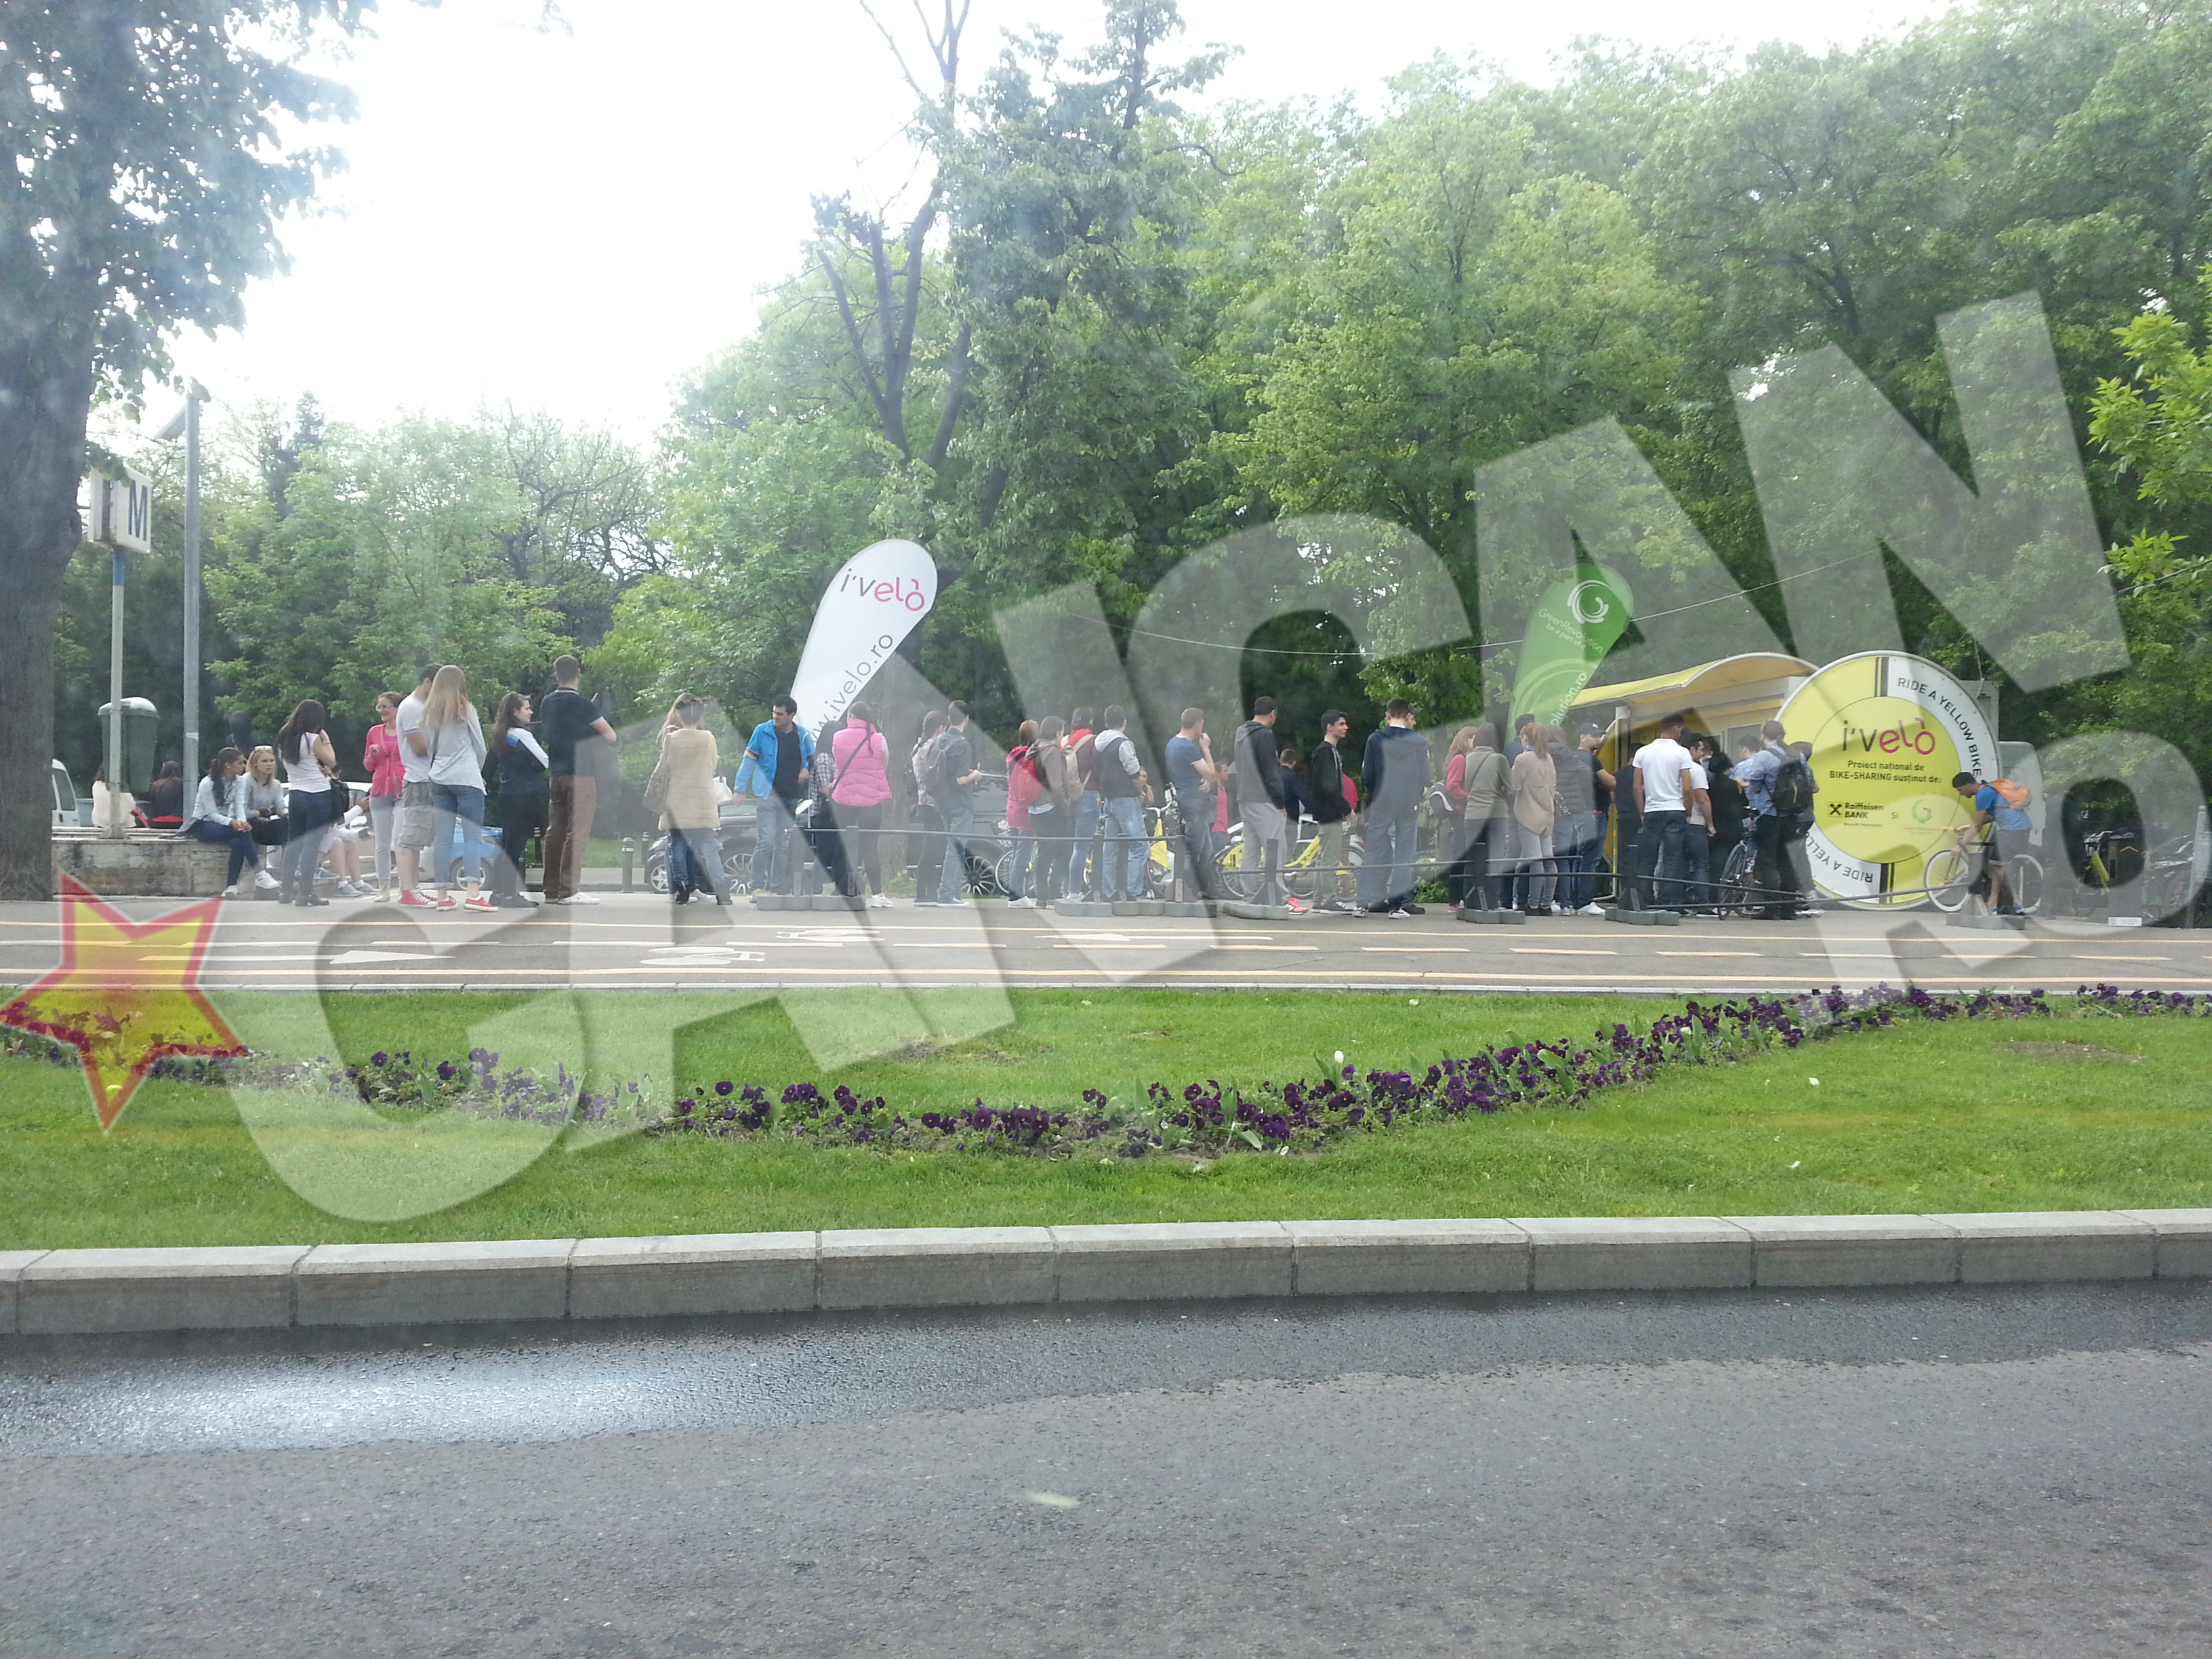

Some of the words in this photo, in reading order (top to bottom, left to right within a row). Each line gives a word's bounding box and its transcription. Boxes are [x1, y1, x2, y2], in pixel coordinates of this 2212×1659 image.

[128, 480, 148, 541] M
[1898, 678, 1927, 694] RIDE
[1928, 690, 1937, 700] A
[1940, 696, 1974, 741] YELLOW
[1830, 771, 1891, 781] BIKE-SHARING
[1845, 802, 1883, 811] Raiffeisen
[1833, 861, 1842, 870] A
[1842, 866, 1873, 883] RIDE
